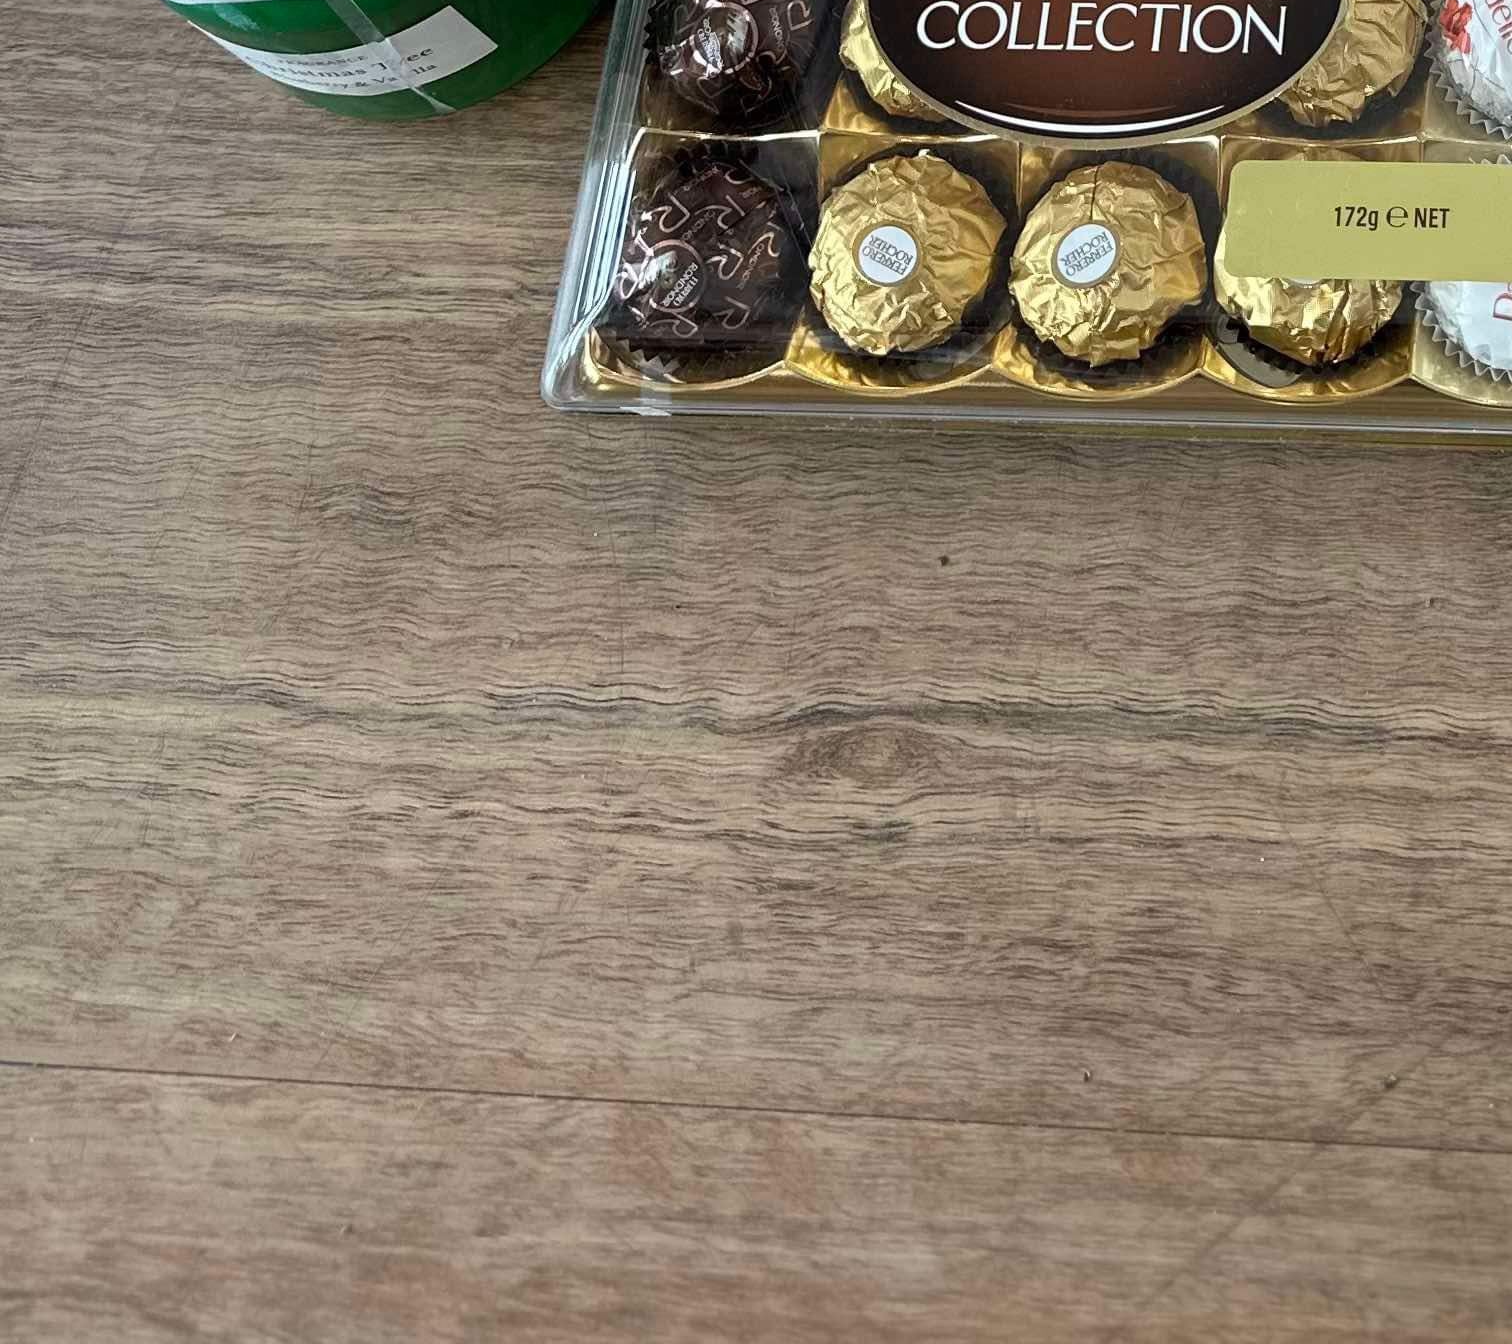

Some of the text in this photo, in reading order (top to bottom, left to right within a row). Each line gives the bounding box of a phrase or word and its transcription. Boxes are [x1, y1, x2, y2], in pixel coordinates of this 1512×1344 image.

[915, 0, 1287, 55] COLLECTION
[372, 63, 438, 85] Valla
[1334, 205, 1379, 232] 172g
[1413, 207, 1450, 230] NET
[862, 245, 908, 275] FERRERO
[869, 235, 914, 266] ROCHER
[1060, 231, 1109, 266] ROCHER
[1065, 241, 1115, 276] FERRERO
